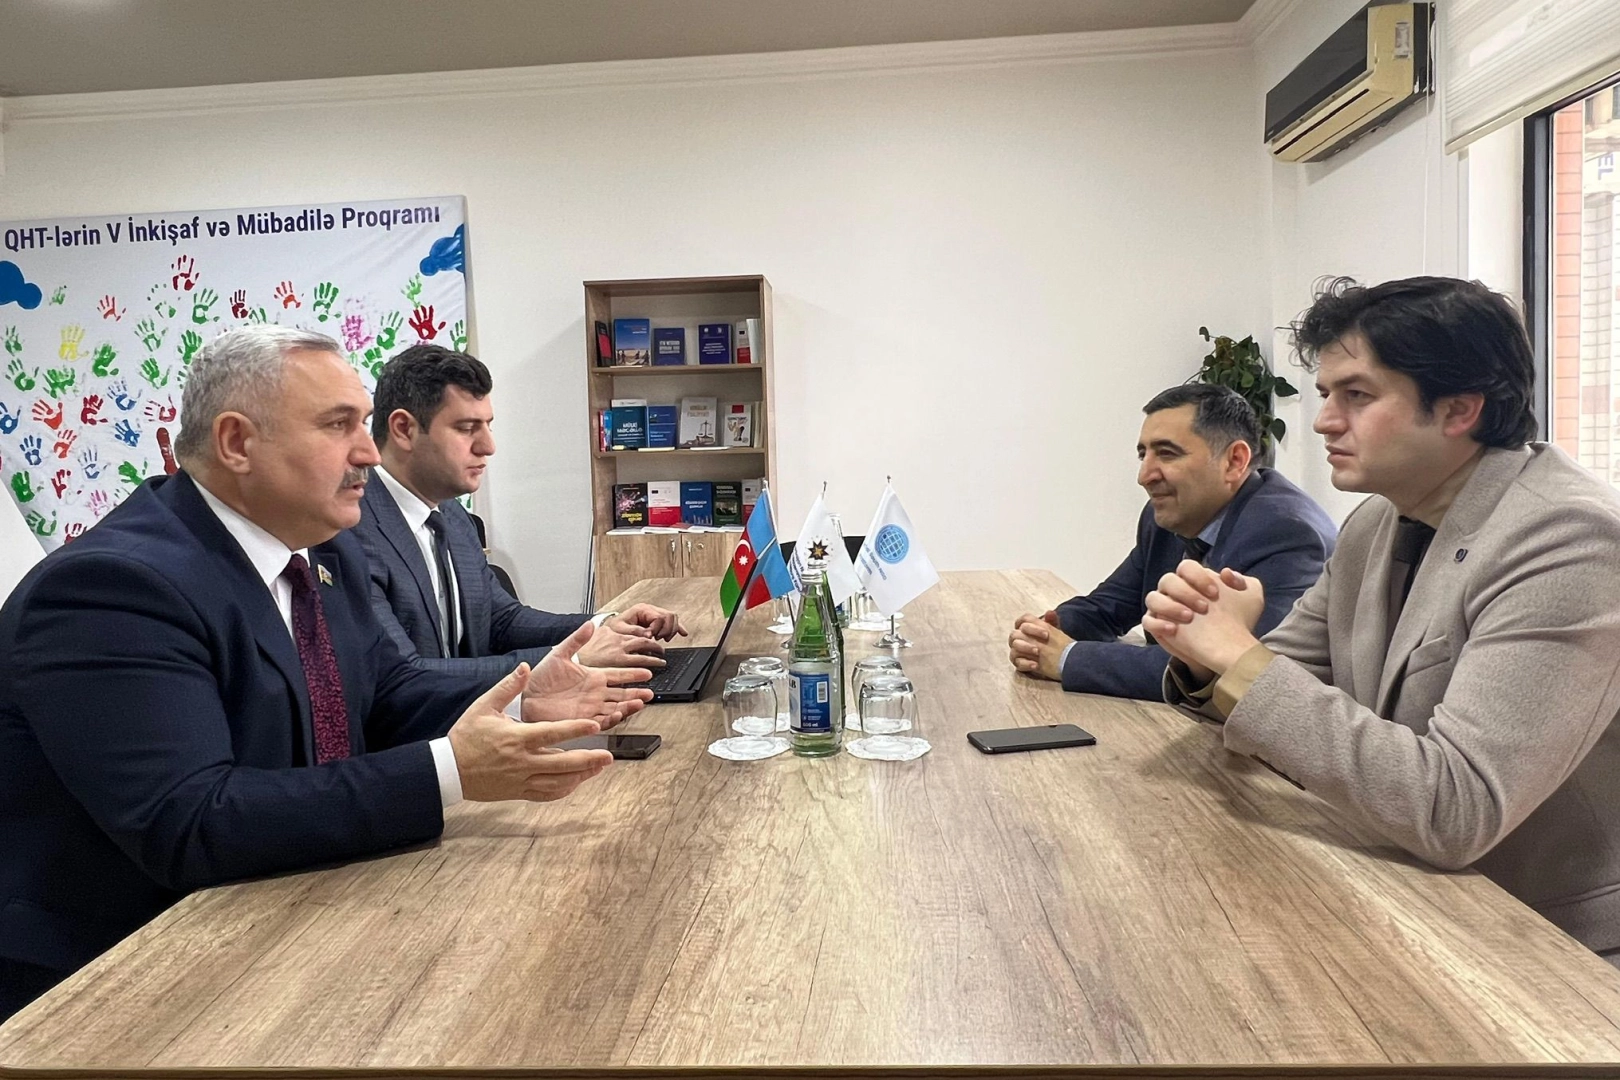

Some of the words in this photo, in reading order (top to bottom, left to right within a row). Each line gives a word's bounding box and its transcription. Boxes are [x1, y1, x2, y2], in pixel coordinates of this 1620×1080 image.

[4, 222, 101, 253] QHT-lərin
[106, 222, 122, 244] V
[128, 215, 199, 247] İnkişaf
[206, 221, 230, 237] və
[236, 208, 335, 236] Mübadilə
[341, 205, 440, 230] Proqramı
